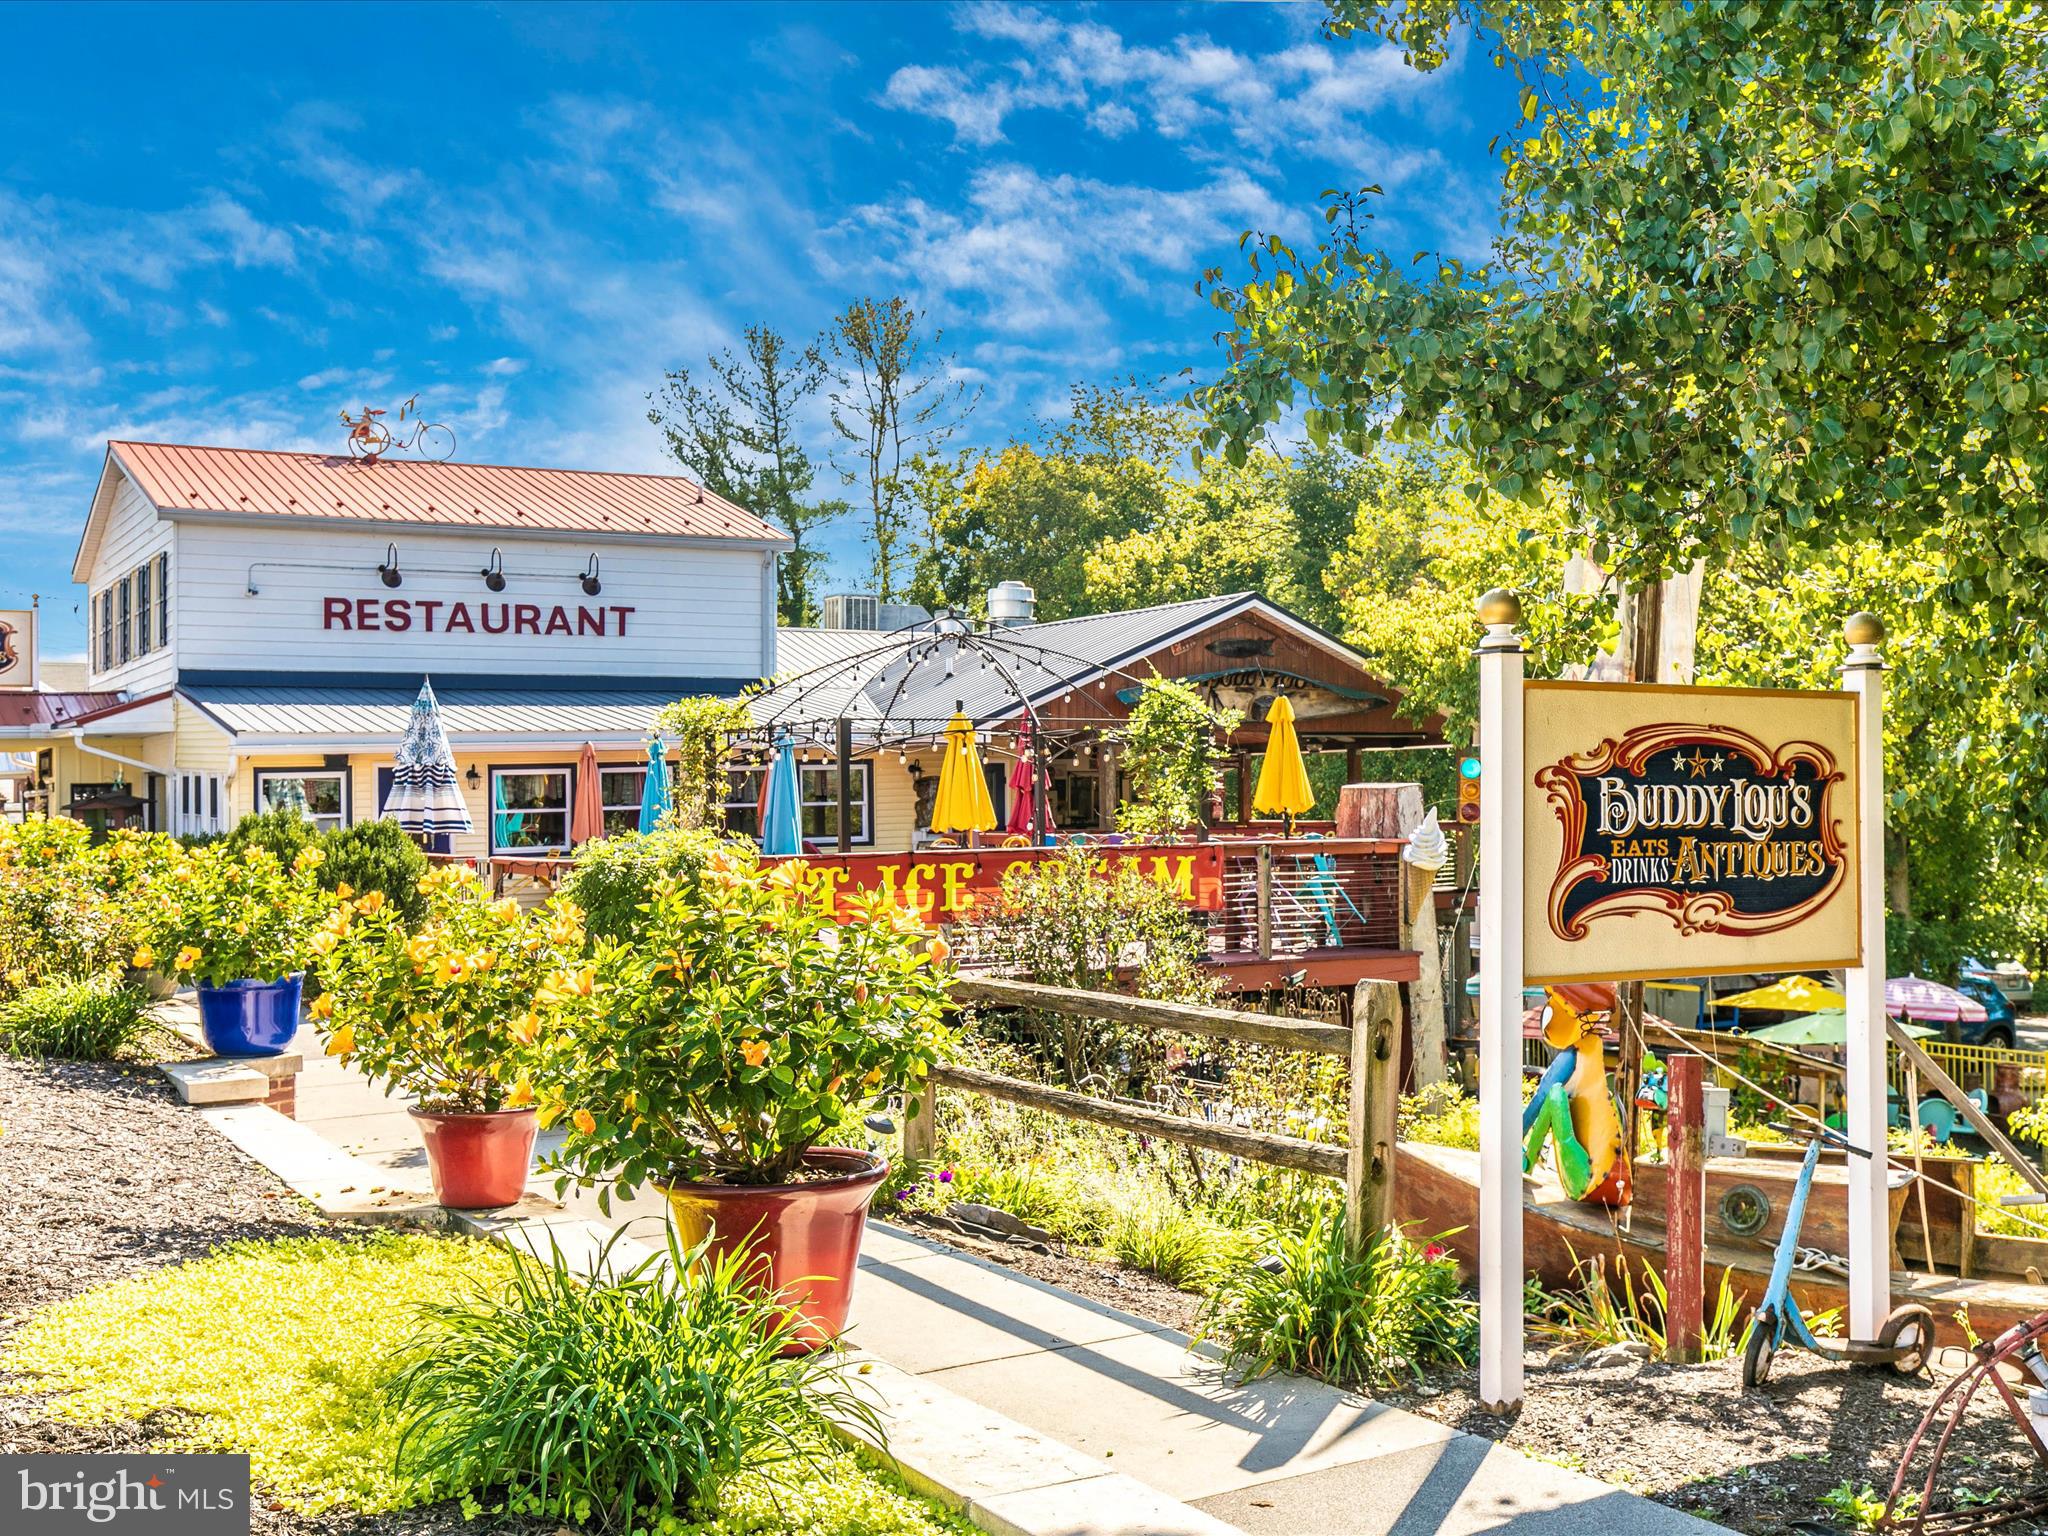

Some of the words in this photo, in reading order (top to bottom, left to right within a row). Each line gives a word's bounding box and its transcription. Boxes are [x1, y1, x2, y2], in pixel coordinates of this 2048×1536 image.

[323, 597, 635, 637] RESTAURANT
[1597, 777, 1731, 836] BUDDY
[1730, 778, 1813, 840] LOU'S
[1610, 839, 1668, 857] EATS
[1671, 837, 1826, 884] ANTIQUES
[877, 862, 976, 914] ICE
[1611, 858, 1668, 884] DRINKS
